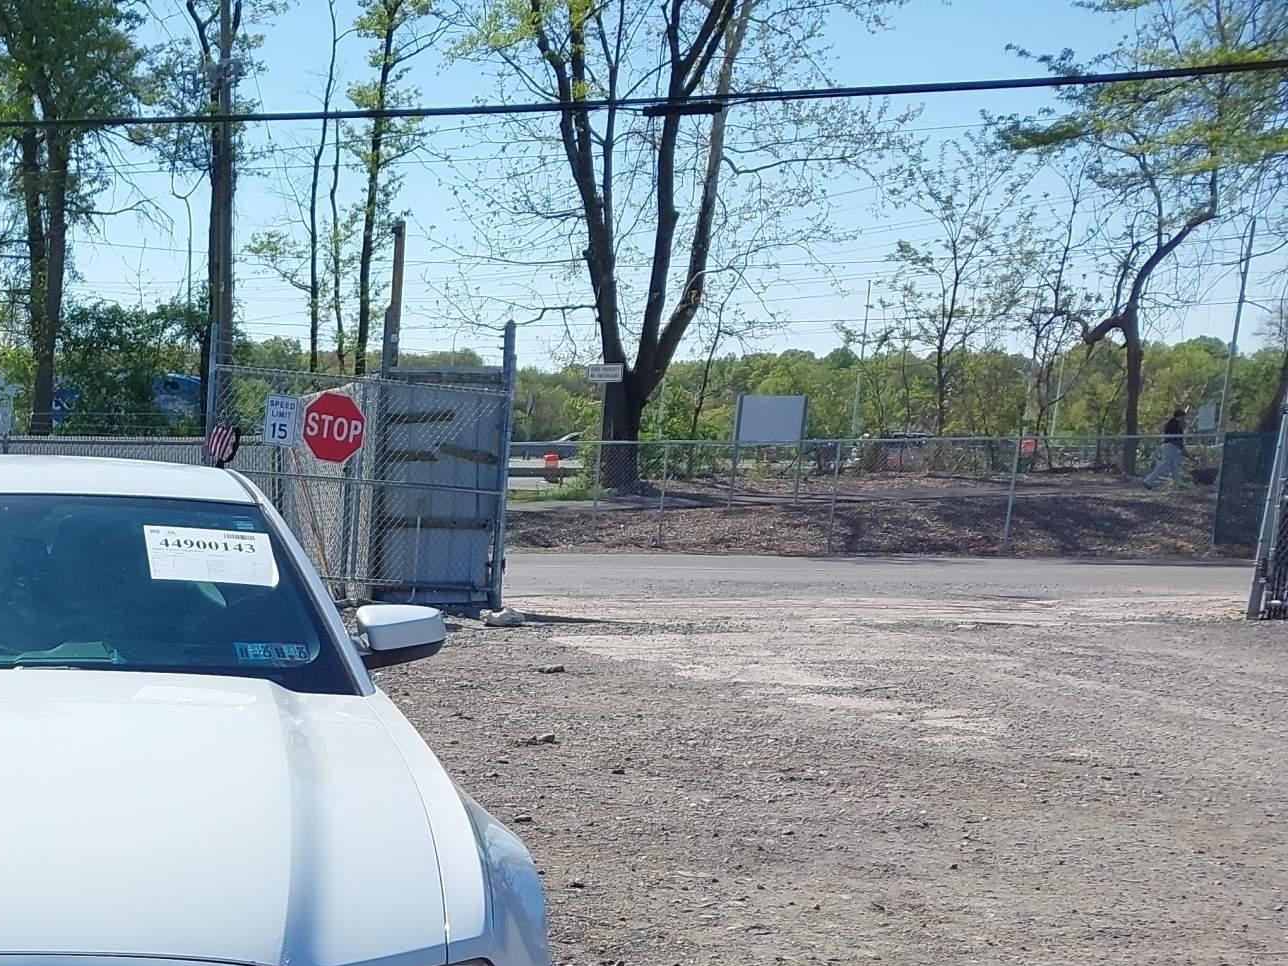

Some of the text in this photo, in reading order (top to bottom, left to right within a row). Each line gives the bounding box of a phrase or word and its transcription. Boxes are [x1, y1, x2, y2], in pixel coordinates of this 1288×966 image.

[269, 399, 296, 411] SPEED
[271, 409, 292, 420] LIMIT
[270, 422, 288, 440] 15
[306, 411, 363, 444] STOP
[159, 537, 256, 554] 44900143
